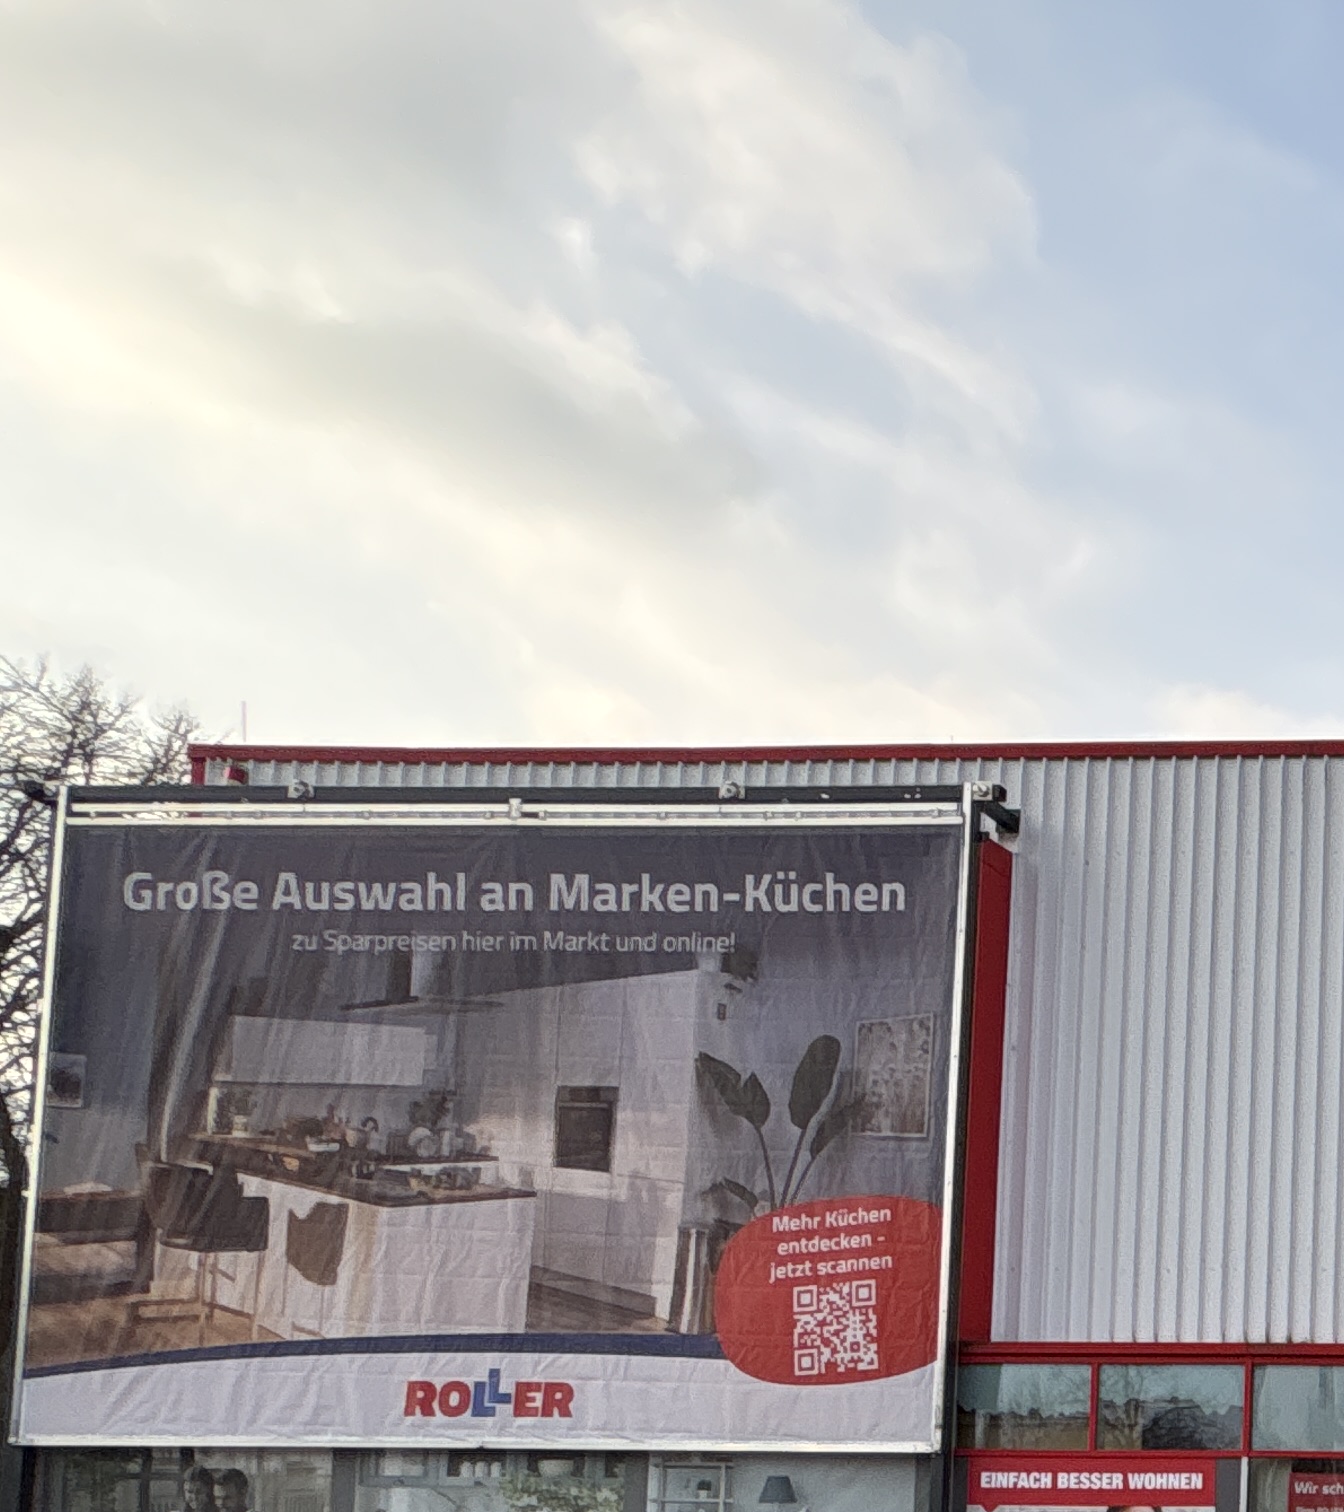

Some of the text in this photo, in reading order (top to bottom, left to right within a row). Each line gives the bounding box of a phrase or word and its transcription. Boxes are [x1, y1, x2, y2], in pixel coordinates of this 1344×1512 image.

[123, 870, 906, 913] Große Auswahl an Marken-Küchen
[292, 929, 737, 956] zu Sparpreisen hier im Markt und online!
[772, 1207, 892, 1233] Mehr Küchen
[777, 1232, 872, 1256] entdecken
[769, 1255, 893, 1284] jetzt scannen
[404, 1368, 575, 1418] ROLLER
[980, 1471, 1204, 1491] EINFACH BESSER WOHNEN
[1294, 1481, 1317, 1496] Wir
